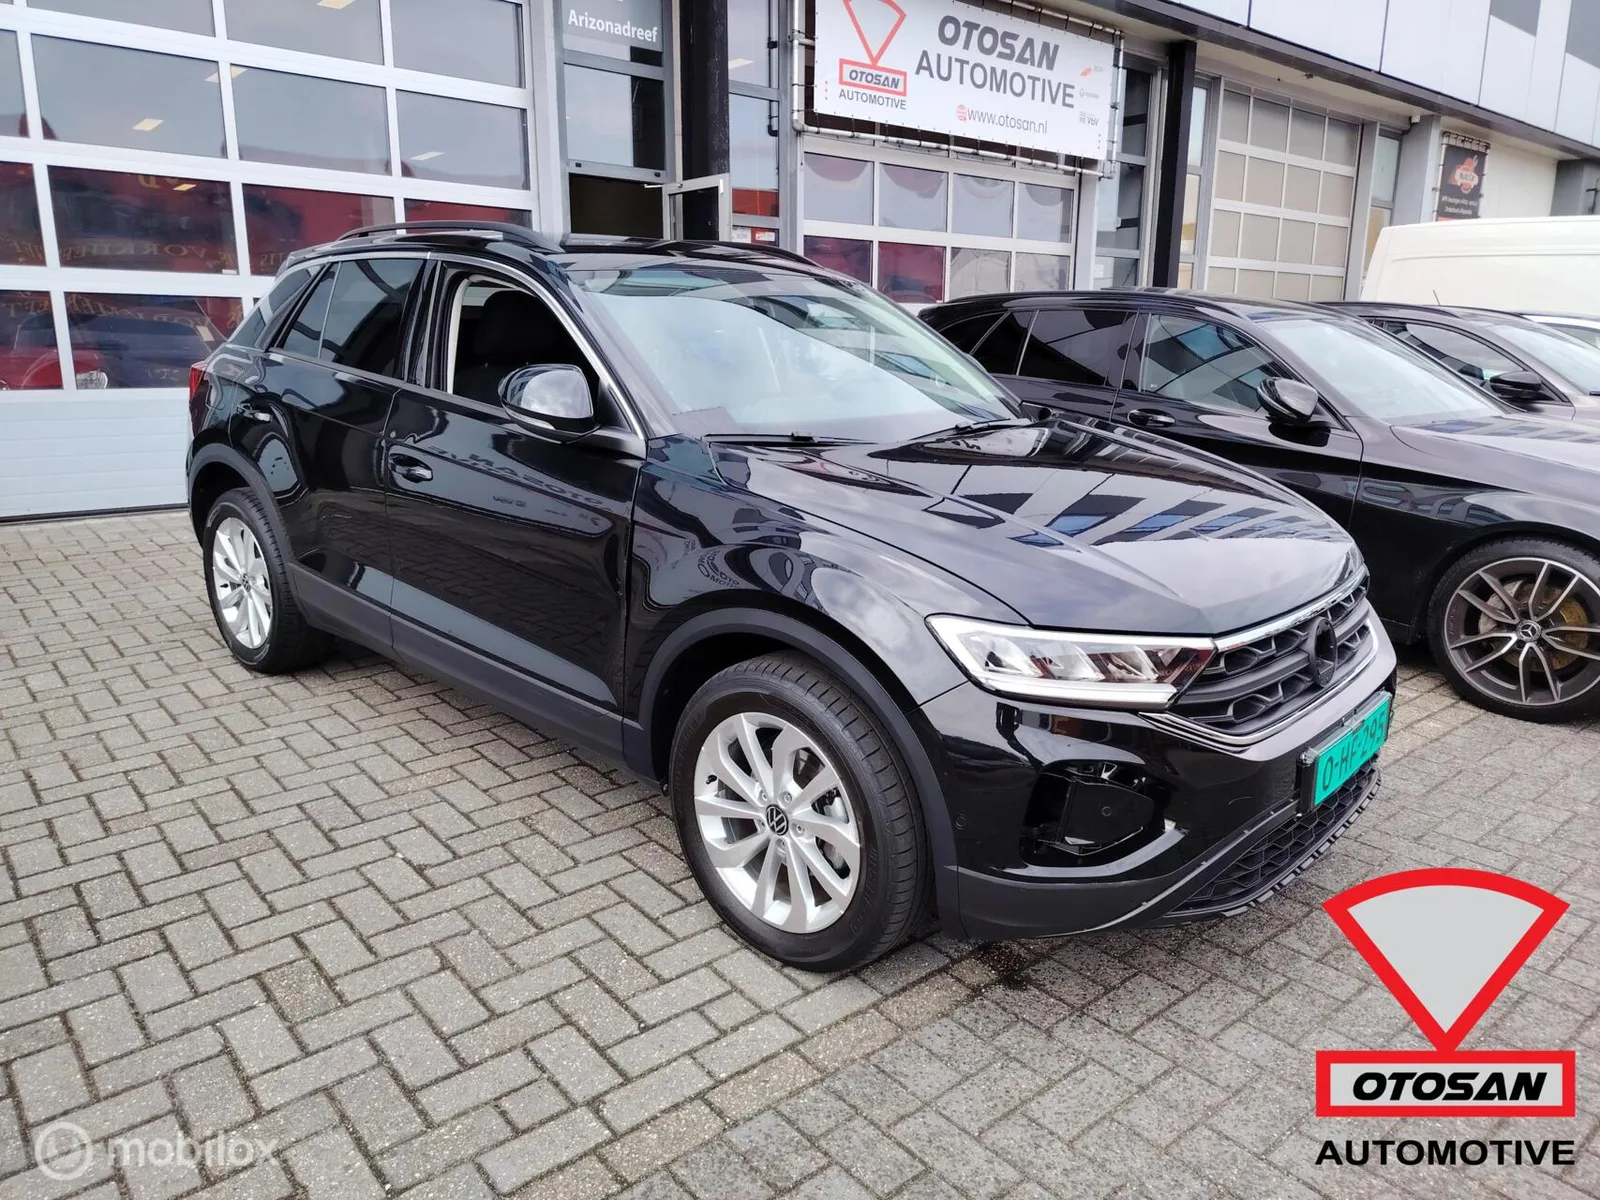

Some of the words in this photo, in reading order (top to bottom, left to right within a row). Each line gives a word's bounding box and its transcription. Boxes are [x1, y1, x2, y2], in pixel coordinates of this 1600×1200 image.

[568, 9, 658, 42] Arizonadreef
[938, 15, 1060, 71] OTOSAN
[849, 69, 900, 90] OTOSAN
[914, 50, 1075, 109] AUTOMOTIVE
[838, 88, 906, 110] AUTOMOTIVE
[967, 109, 1047, 135] www.otosan.nl
